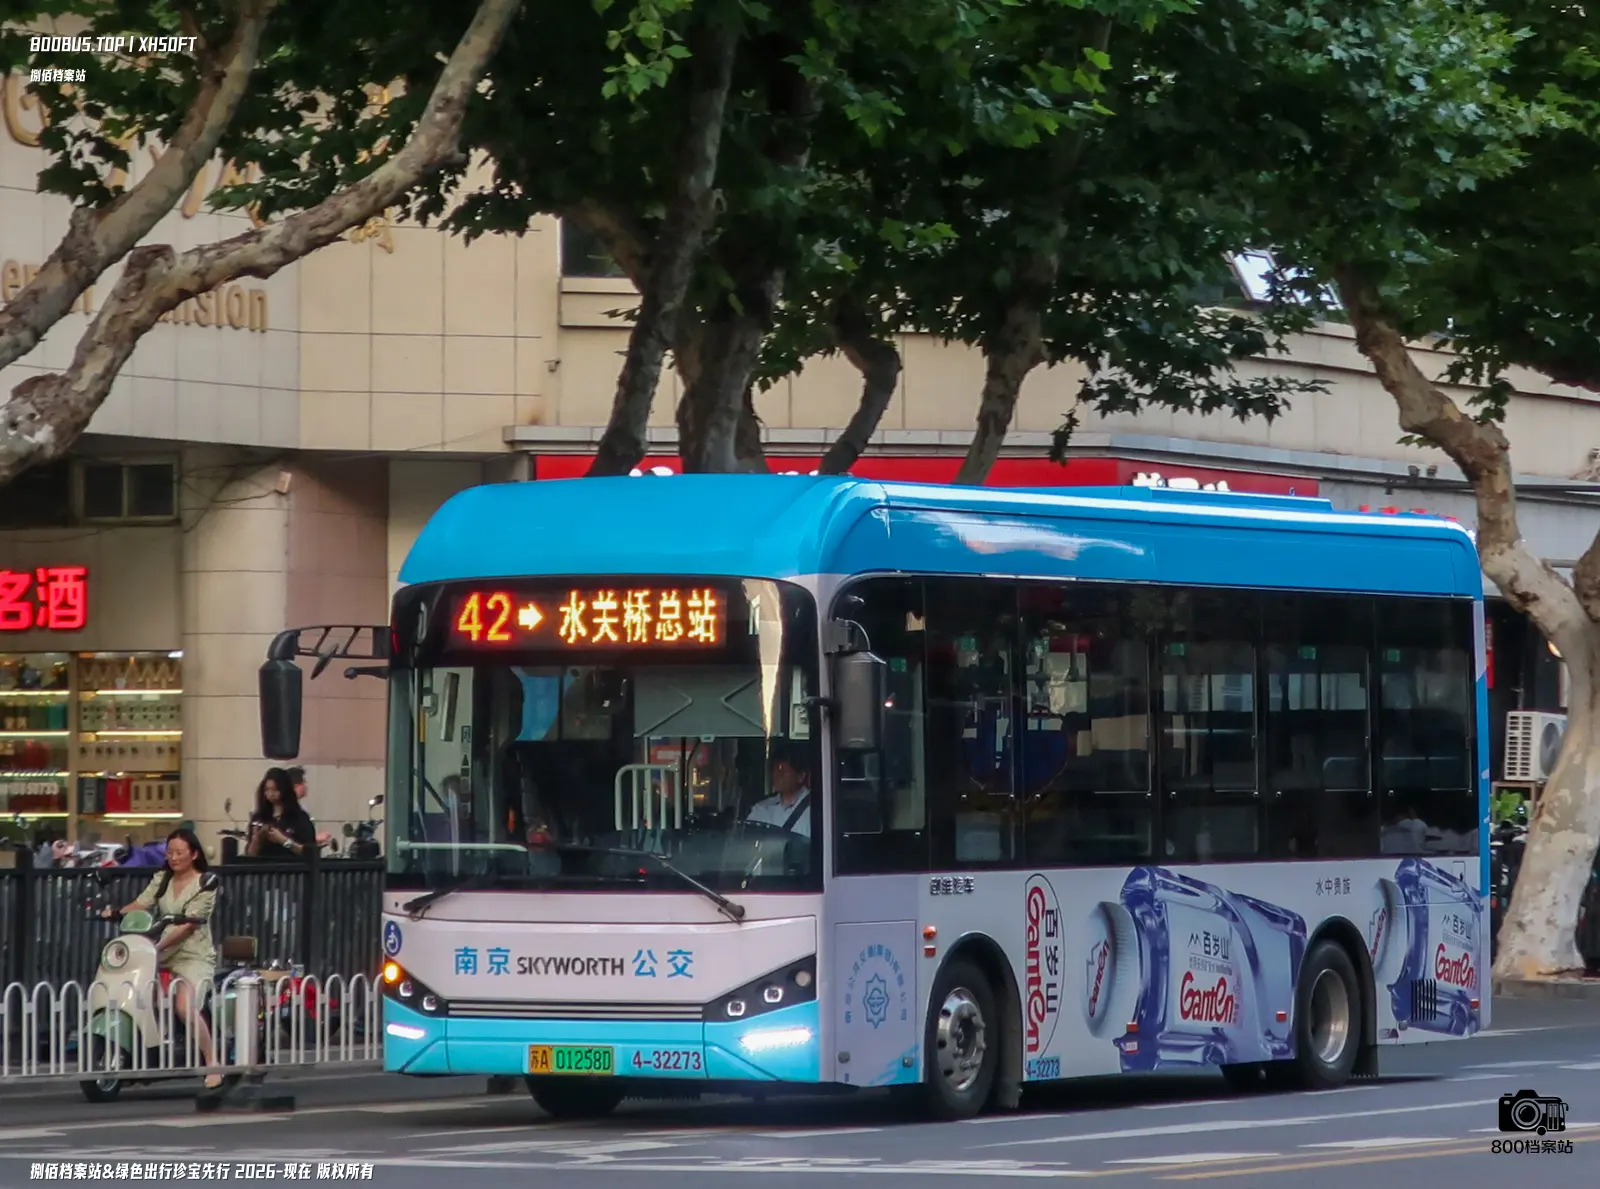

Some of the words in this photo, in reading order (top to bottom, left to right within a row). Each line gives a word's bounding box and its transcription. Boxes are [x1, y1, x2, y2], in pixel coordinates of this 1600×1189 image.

[0, 566, 88, 631] 名酒
[458, 592, 512, 642] 42
[558, 588, 718, 644] 水关桥总站
[1315, 876, 1352, 896] 水中贵族
[1044, 907, 1059, 1014] 百岁山
[1203, 929, 1230, 961] 百岁山
[454, 946, 511, 976] 南京
[516, 956, 625, 976] SKYWORTH
[631, 948, 695, 979] 公交
[631, 1050, 703, 1071] 4-32273
